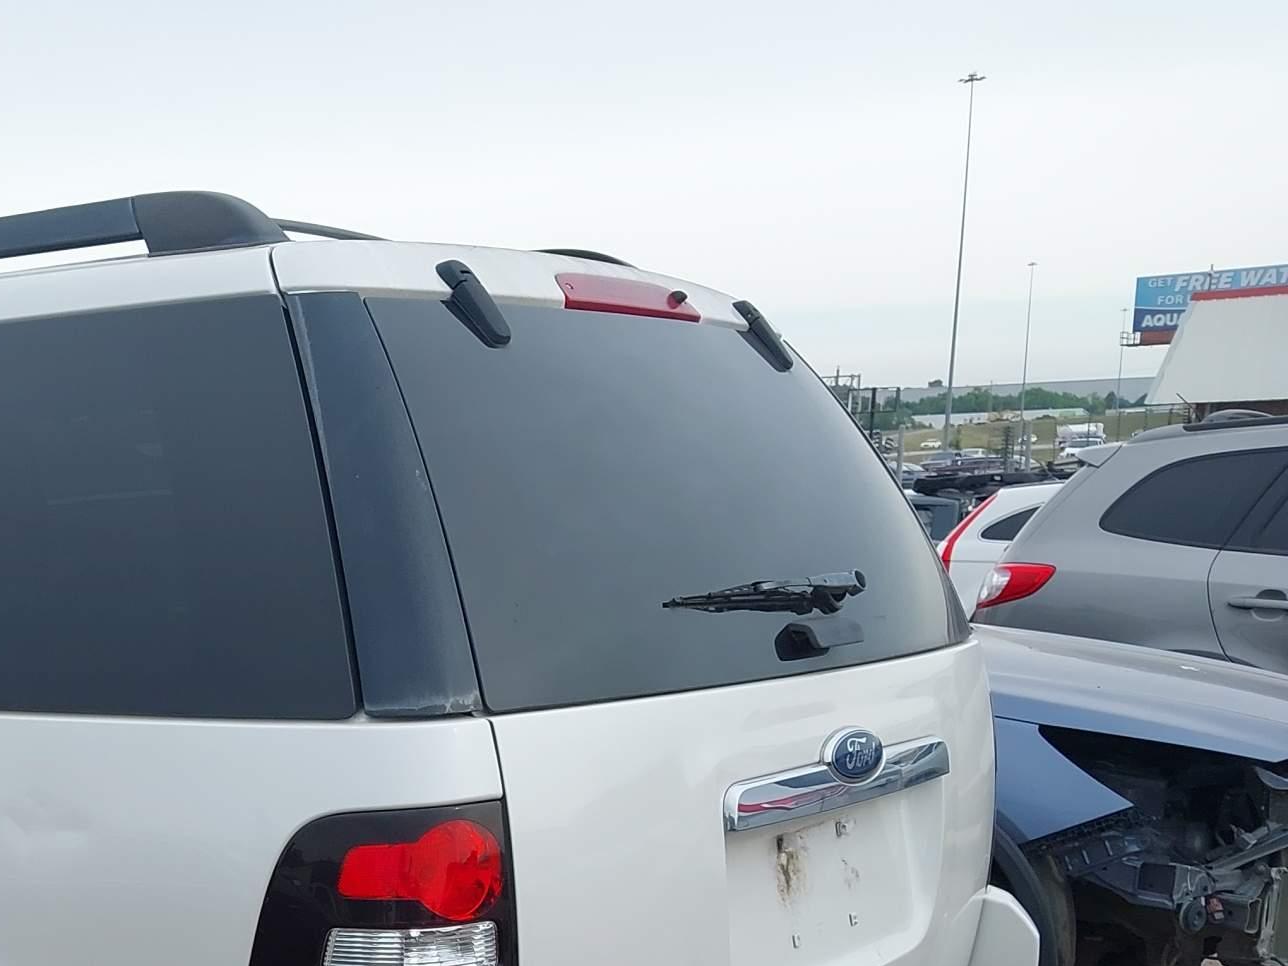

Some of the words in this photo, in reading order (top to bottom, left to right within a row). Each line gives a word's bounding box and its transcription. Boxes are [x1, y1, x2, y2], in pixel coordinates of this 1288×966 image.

[1148, 277, 1172, 288] GET
[1174, 271, 1234, 292] FREE
[1157, 295, 1183, 305] FOR
[1141, 313, 1182, 328] AQU
